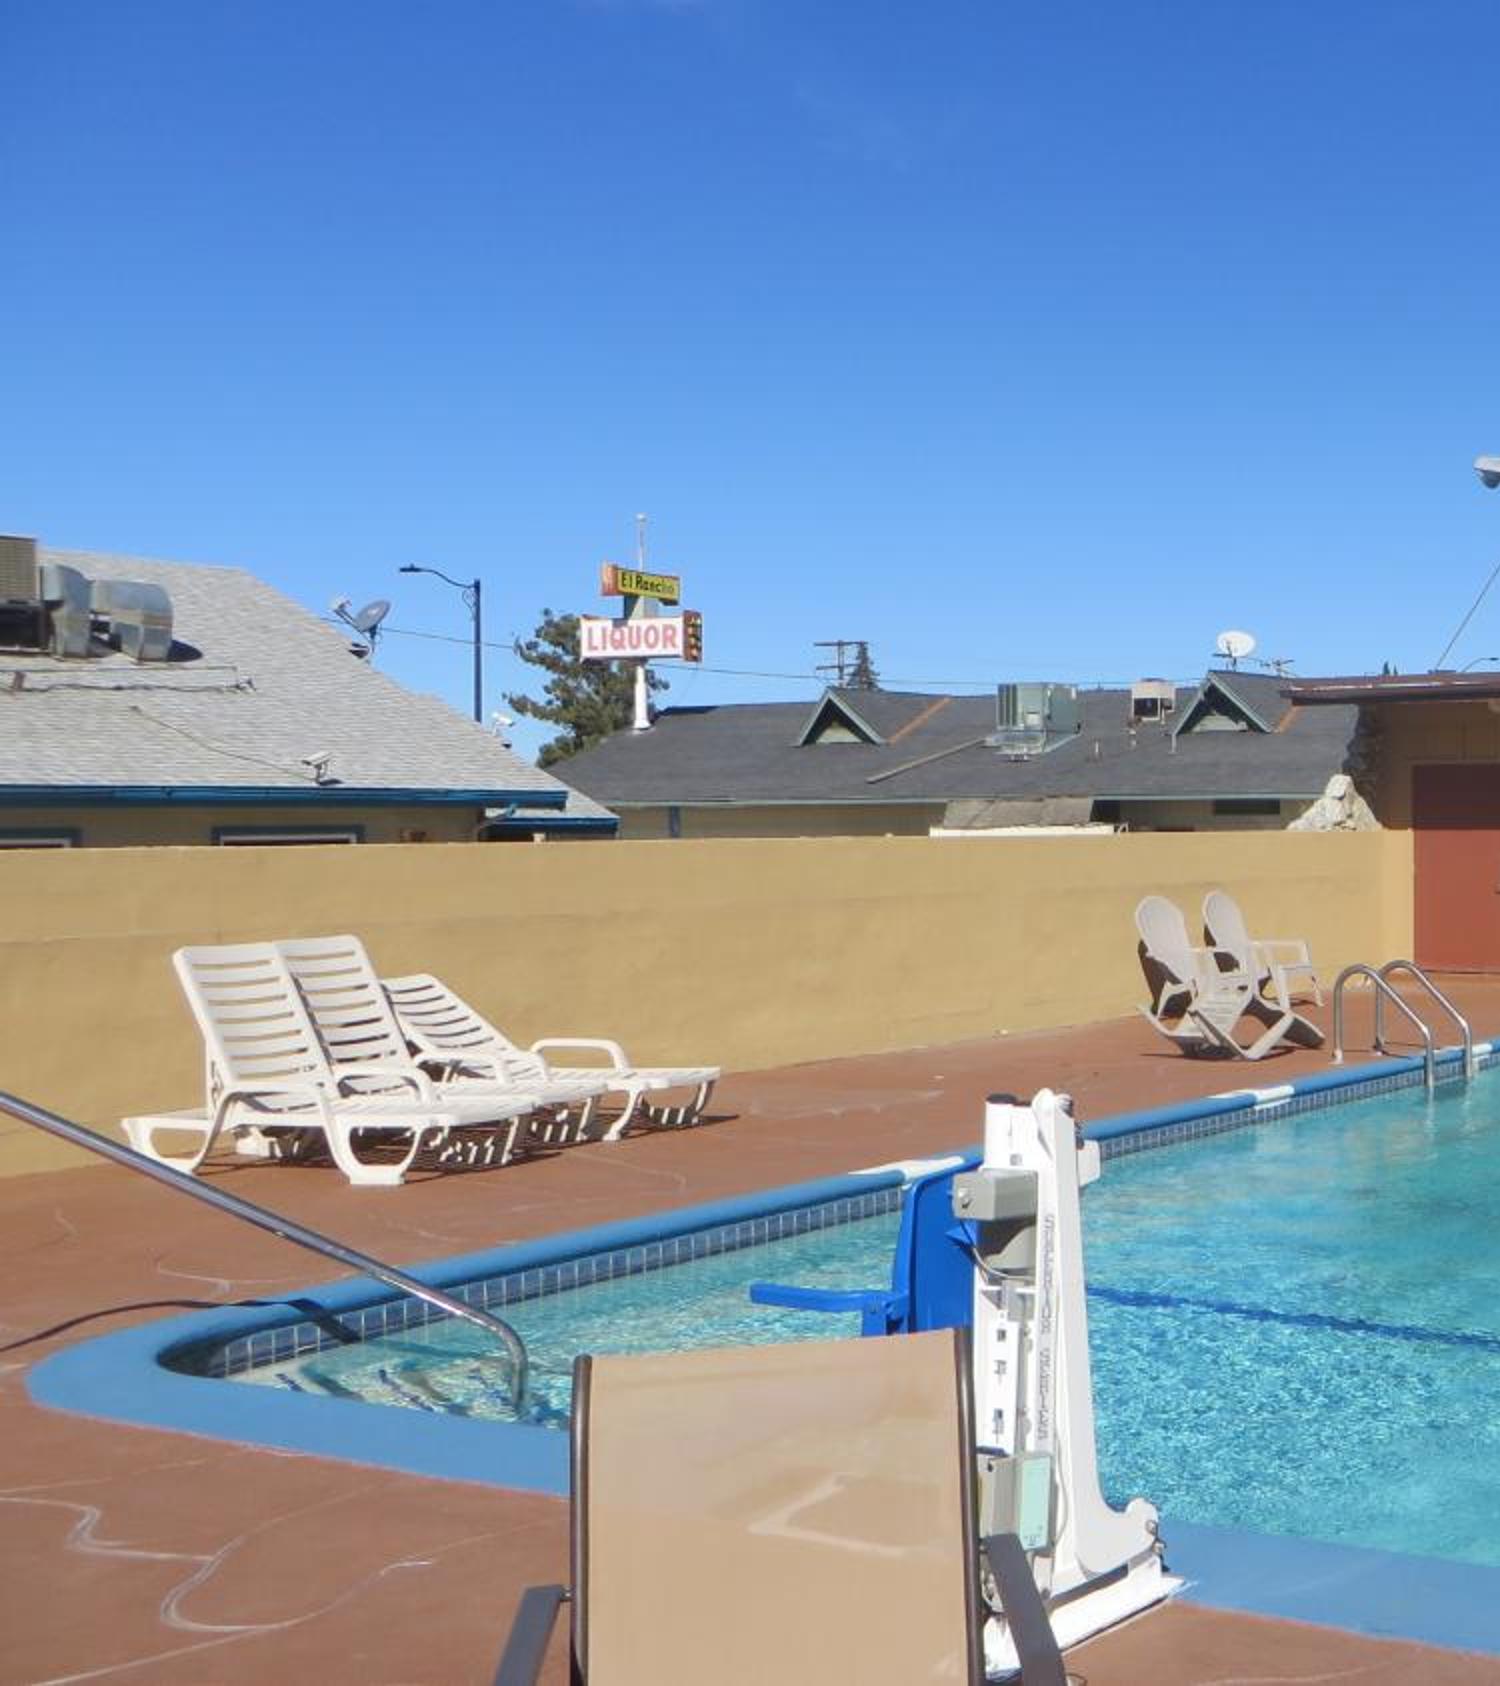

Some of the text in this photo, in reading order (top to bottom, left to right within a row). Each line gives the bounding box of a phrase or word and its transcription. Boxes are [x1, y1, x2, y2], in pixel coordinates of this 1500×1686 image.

[621, 571, 675, 593] El Rancho
[587, 624, 678, 651] LIQUOR
